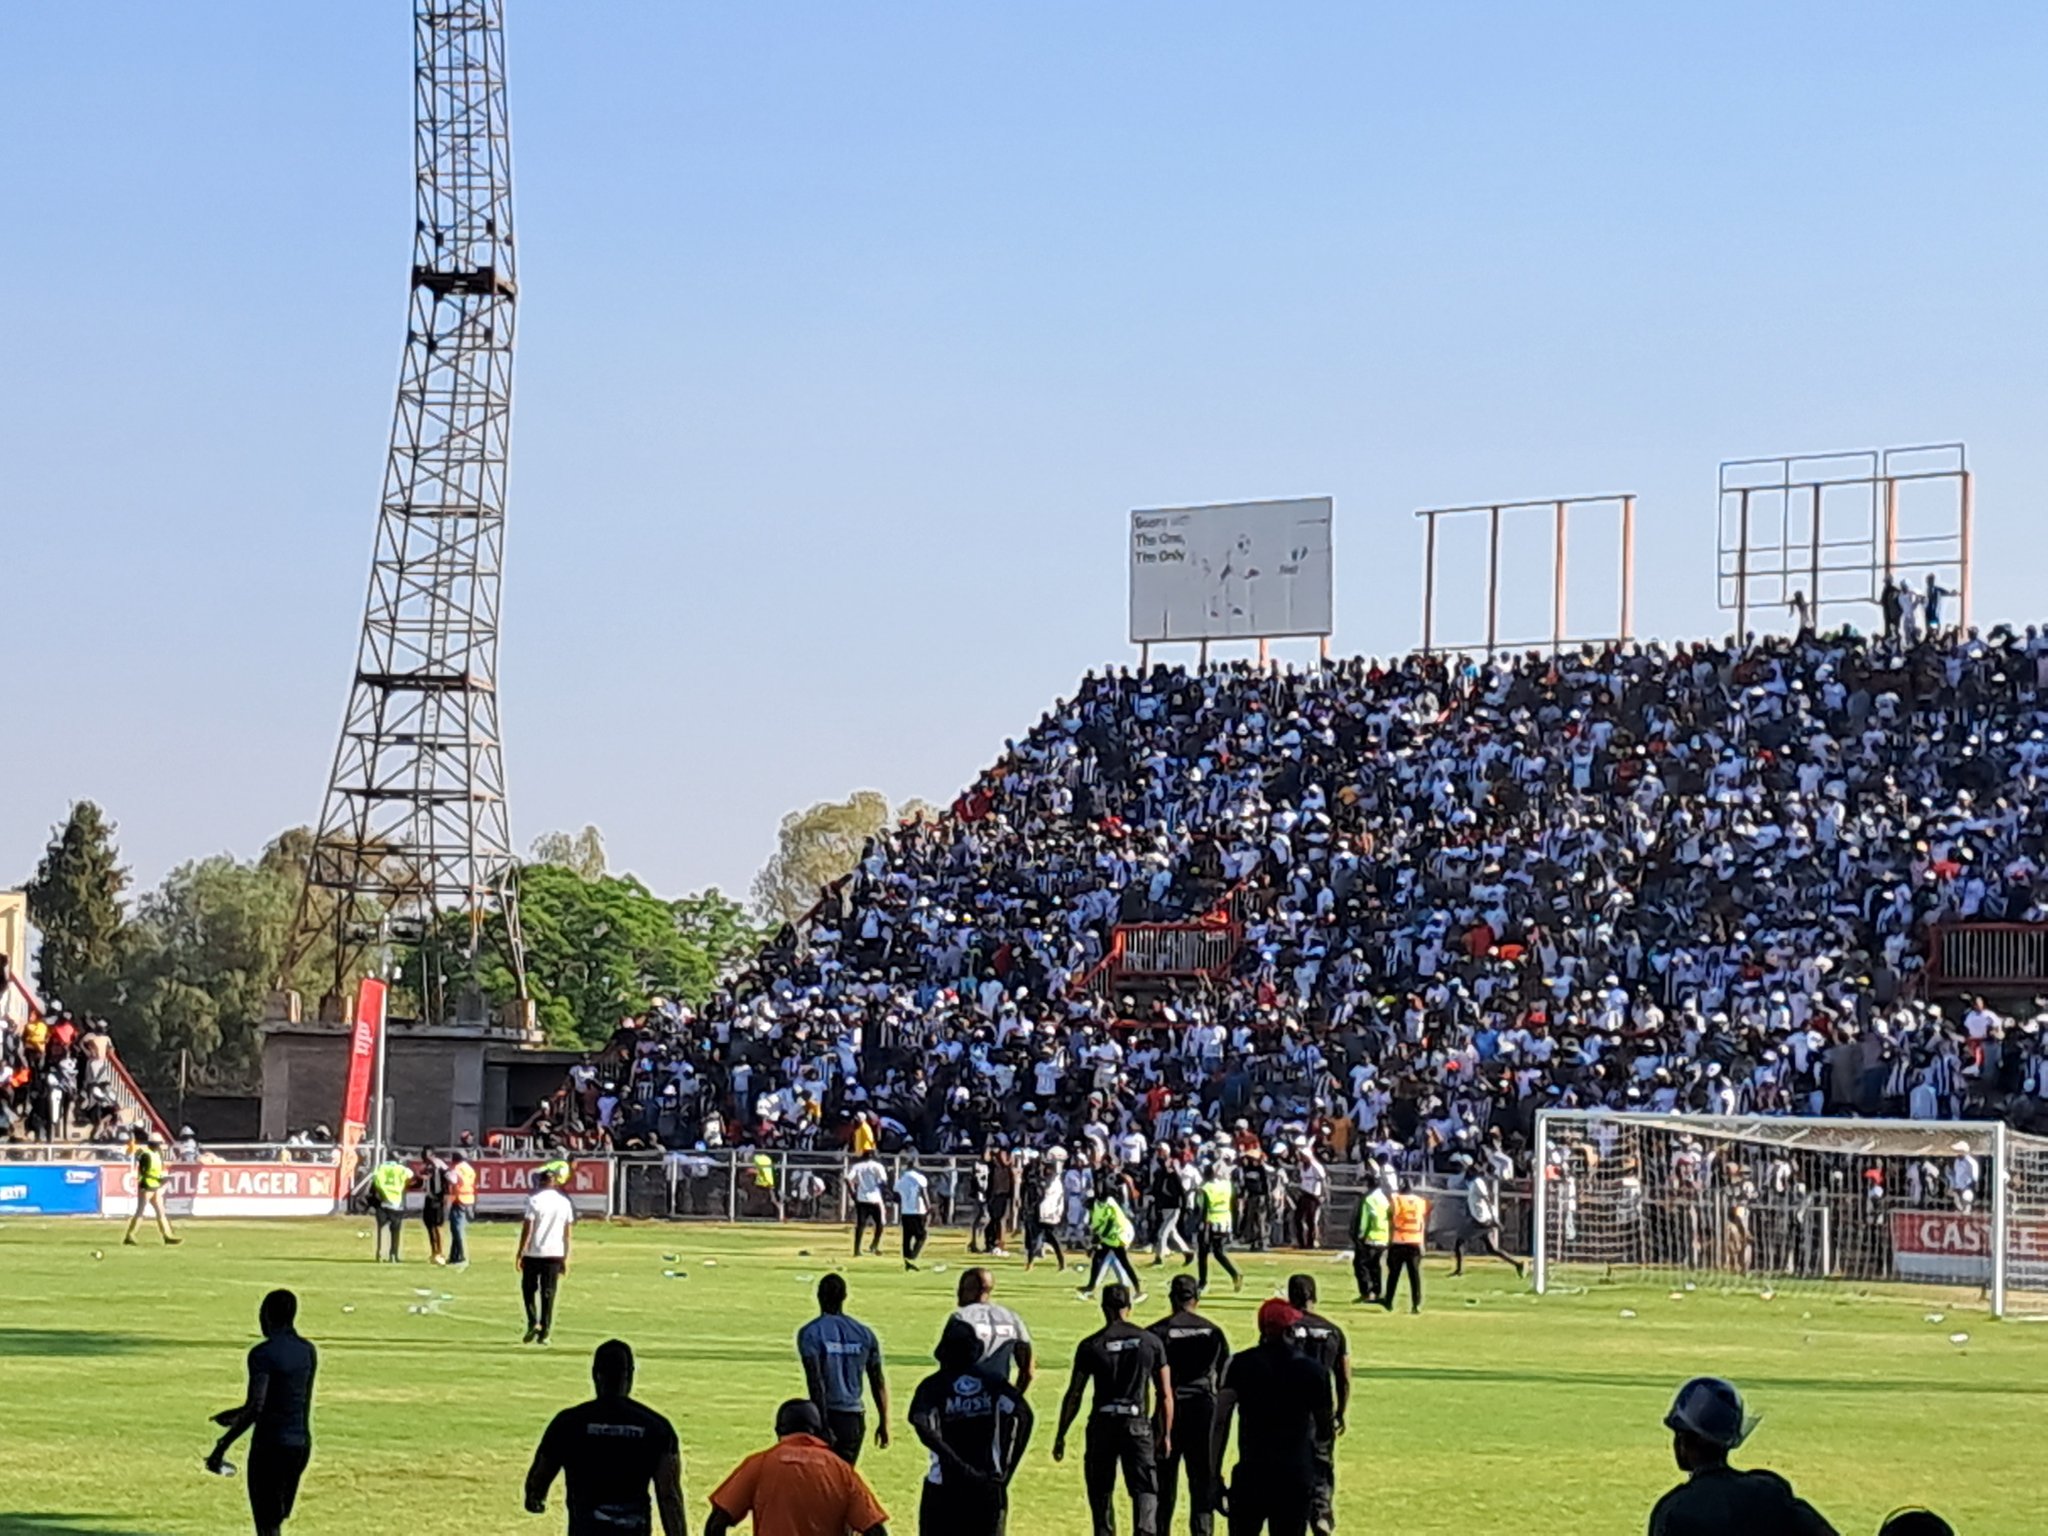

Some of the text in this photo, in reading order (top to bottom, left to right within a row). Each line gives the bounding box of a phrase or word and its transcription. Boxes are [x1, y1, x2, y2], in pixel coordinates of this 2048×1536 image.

[1159, 549, 1186, 562] Only
[122, 1171, 210, 1194] CTLE
[223, 1171, 298, 1194] LAGER
